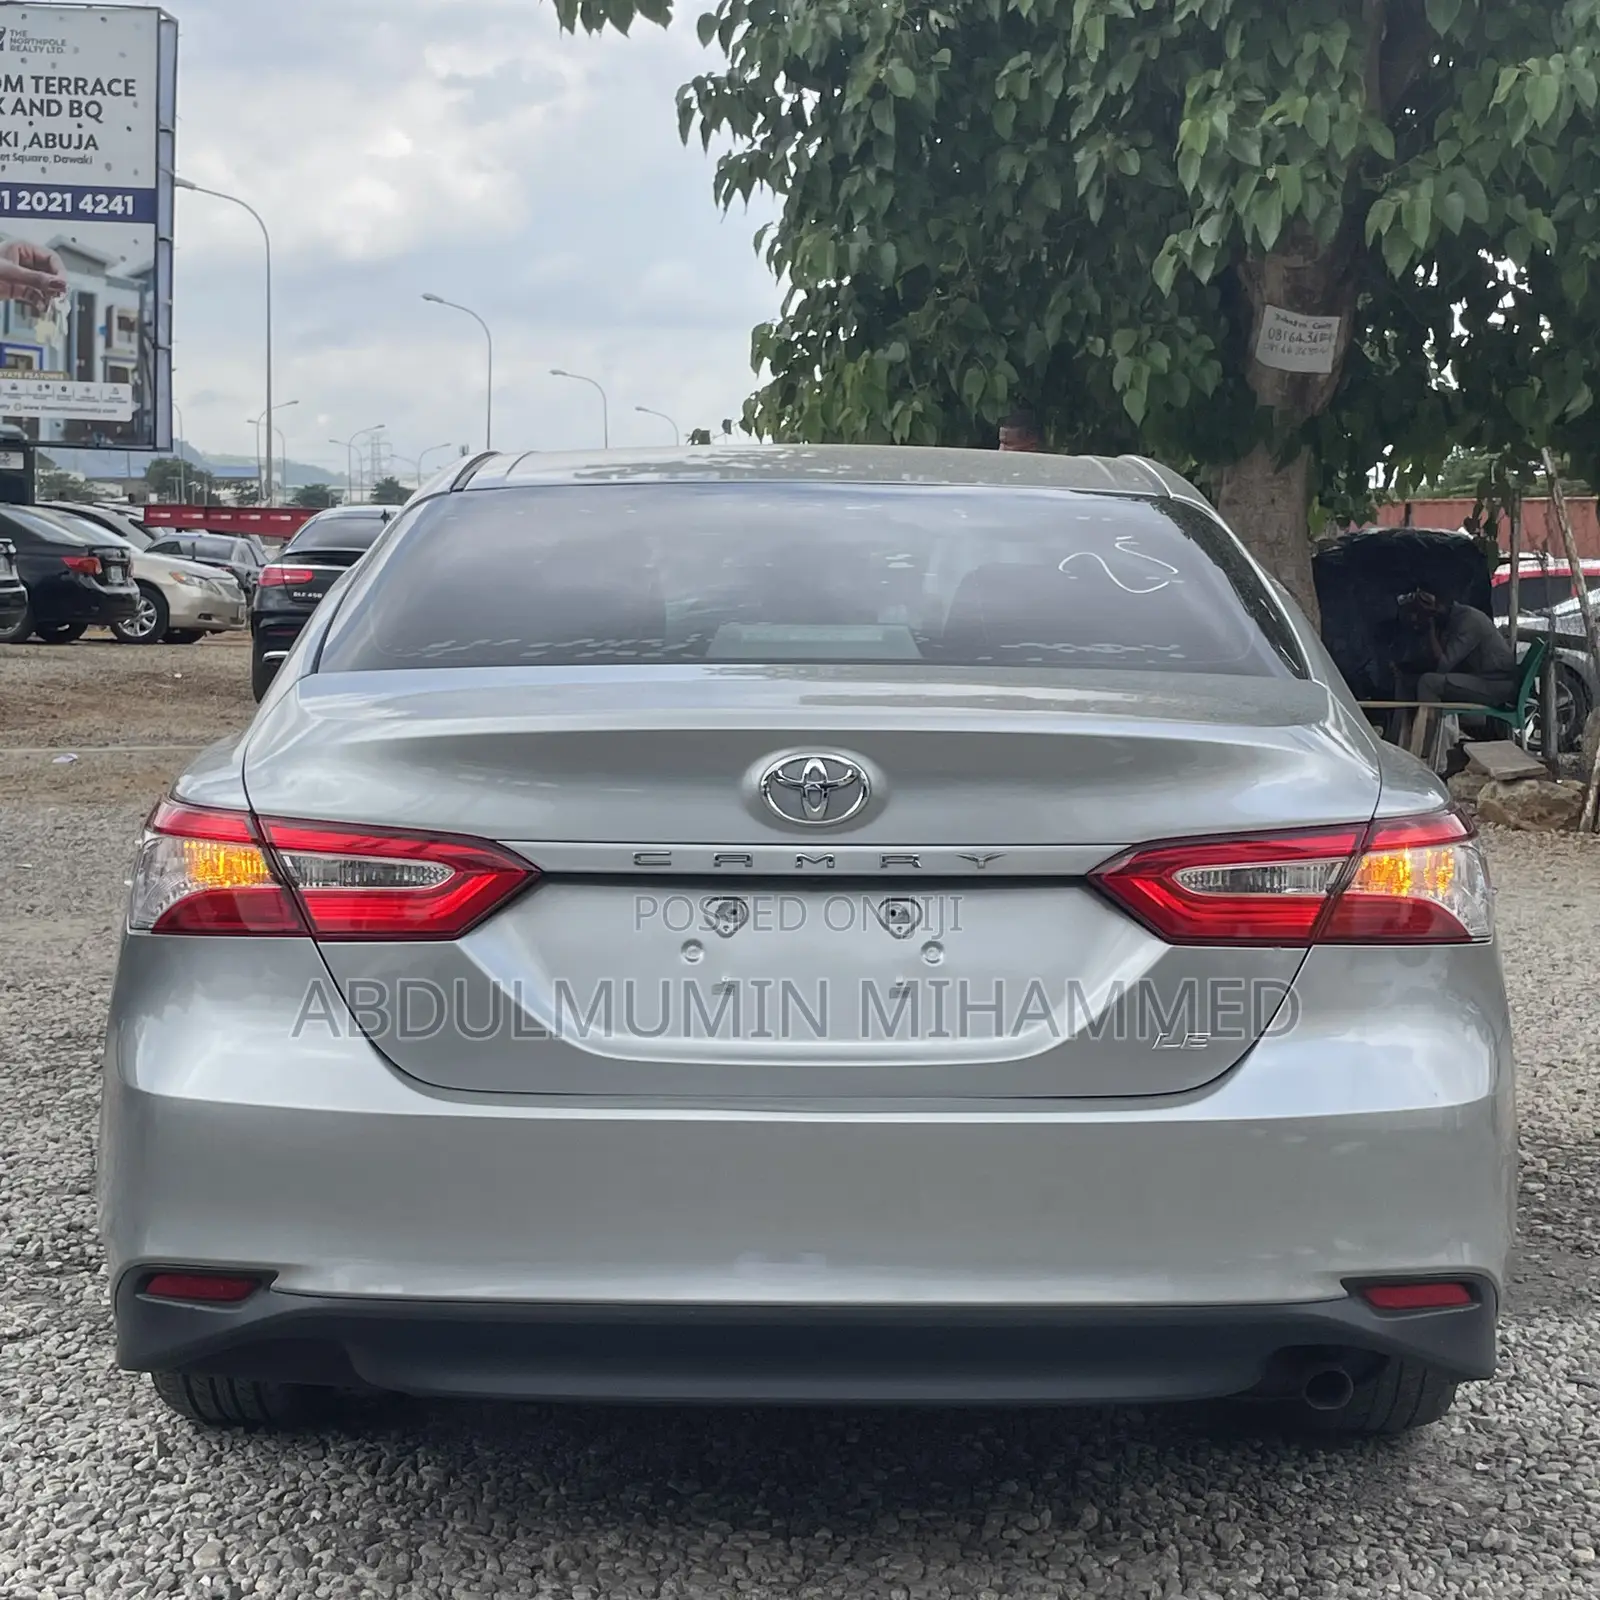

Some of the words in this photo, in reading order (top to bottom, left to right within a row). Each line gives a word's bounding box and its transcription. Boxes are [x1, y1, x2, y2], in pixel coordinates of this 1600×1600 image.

[9, 29, 28, 38] THE
[10, 37, 67, 47] NORTHPOLE
[30, 75, 137, 97] TERRACE
[10, 96, 63, 118] AND
[69, 99, 104, 124] BQ
[16, 190, 73, 213] 2021
[78, 193, 134, 216] 4241
[632, 851, 1007, 869] CAMRY
[1151, 1032, 1212, 1050] LE
